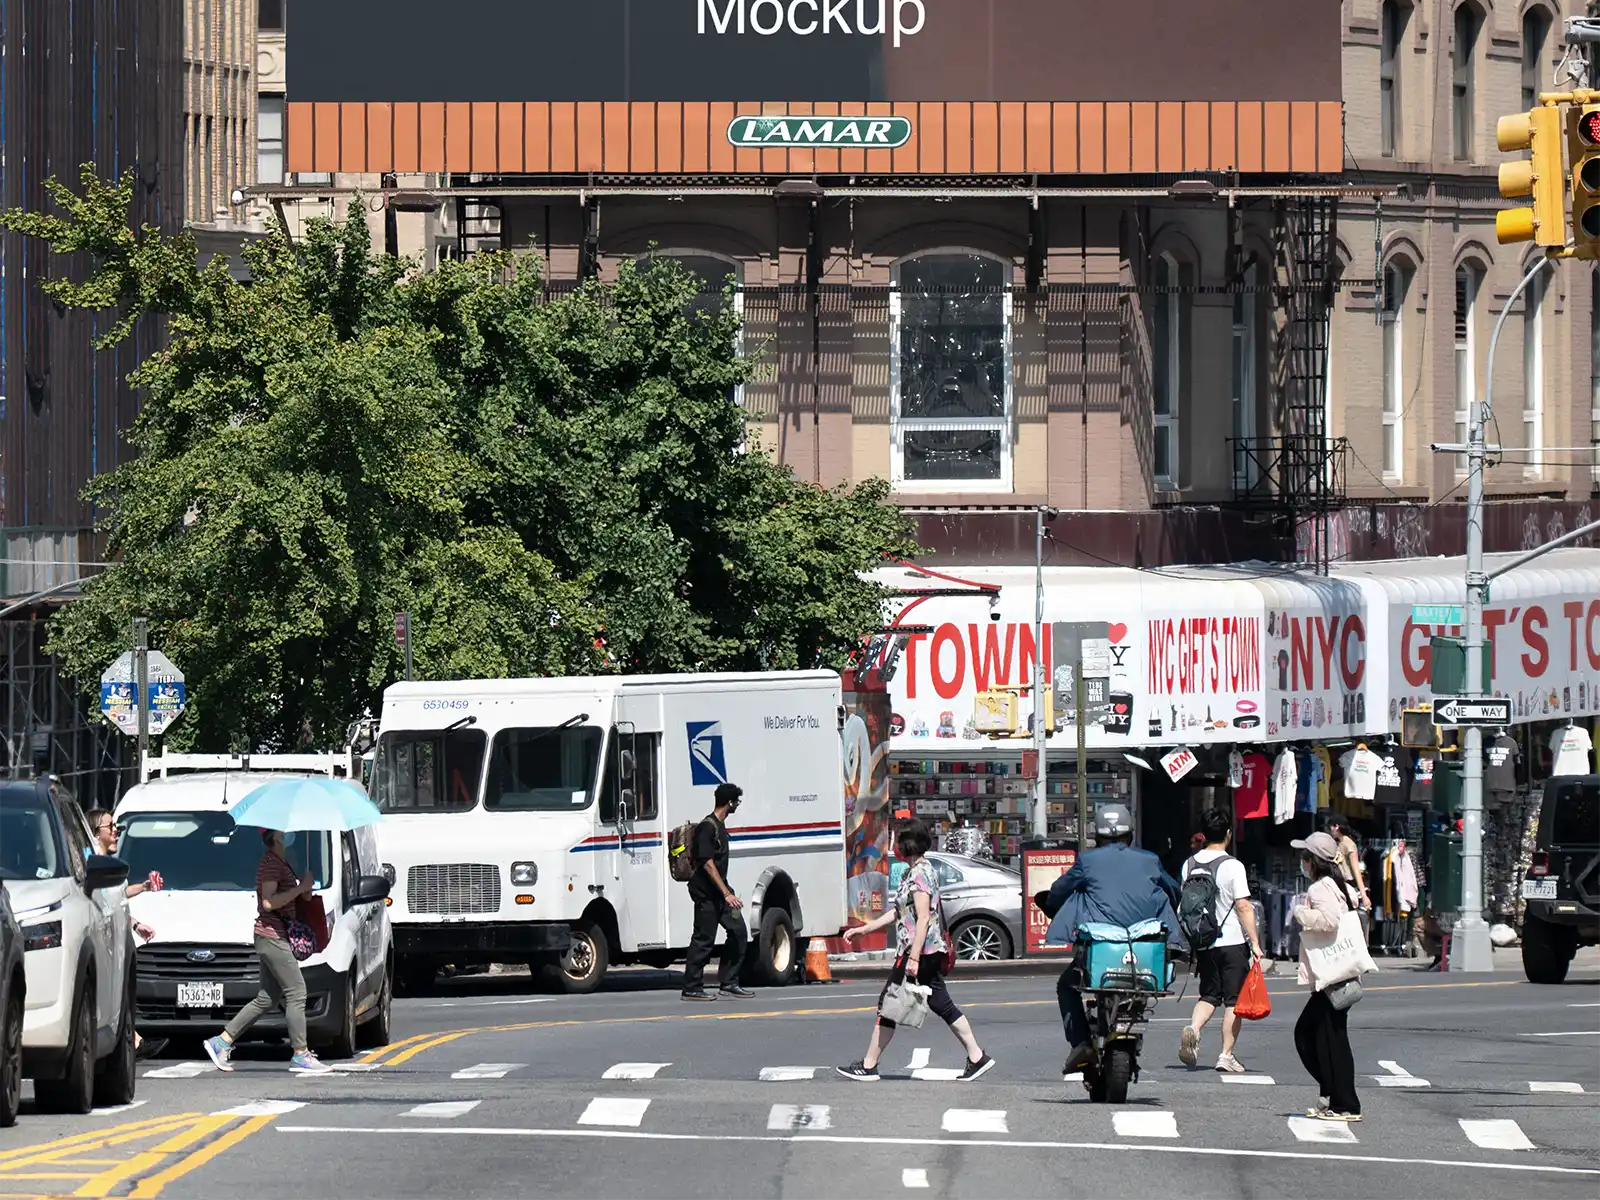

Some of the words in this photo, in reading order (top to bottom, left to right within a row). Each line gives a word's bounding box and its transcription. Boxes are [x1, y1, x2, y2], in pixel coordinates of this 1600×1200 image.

[742, 120, 892, 142] LAMAR
[1148, 618, 1175, 695] NYC
[1178, 616, 1219, 695] GIFT'S
[1222, 615, 1260, 693] TOWN
[1291, 614, 1366, 692] NYC
[1401, 605, 1550, 687] GT'S
[903, 623, 1051, 699] TOWN
[423, 700, 469, 710] 6530459
[1445, 706, 1468, 717] ONE
[1481, 706, 1504, 717] WAY
[764, 716, 774, 729] We
[775, 715, 796, 729] Deliver
[797, 715, 807, 728] For
[1168, 750, 1192, 775] ATM
[1245, 770, 1254, 789] 7
